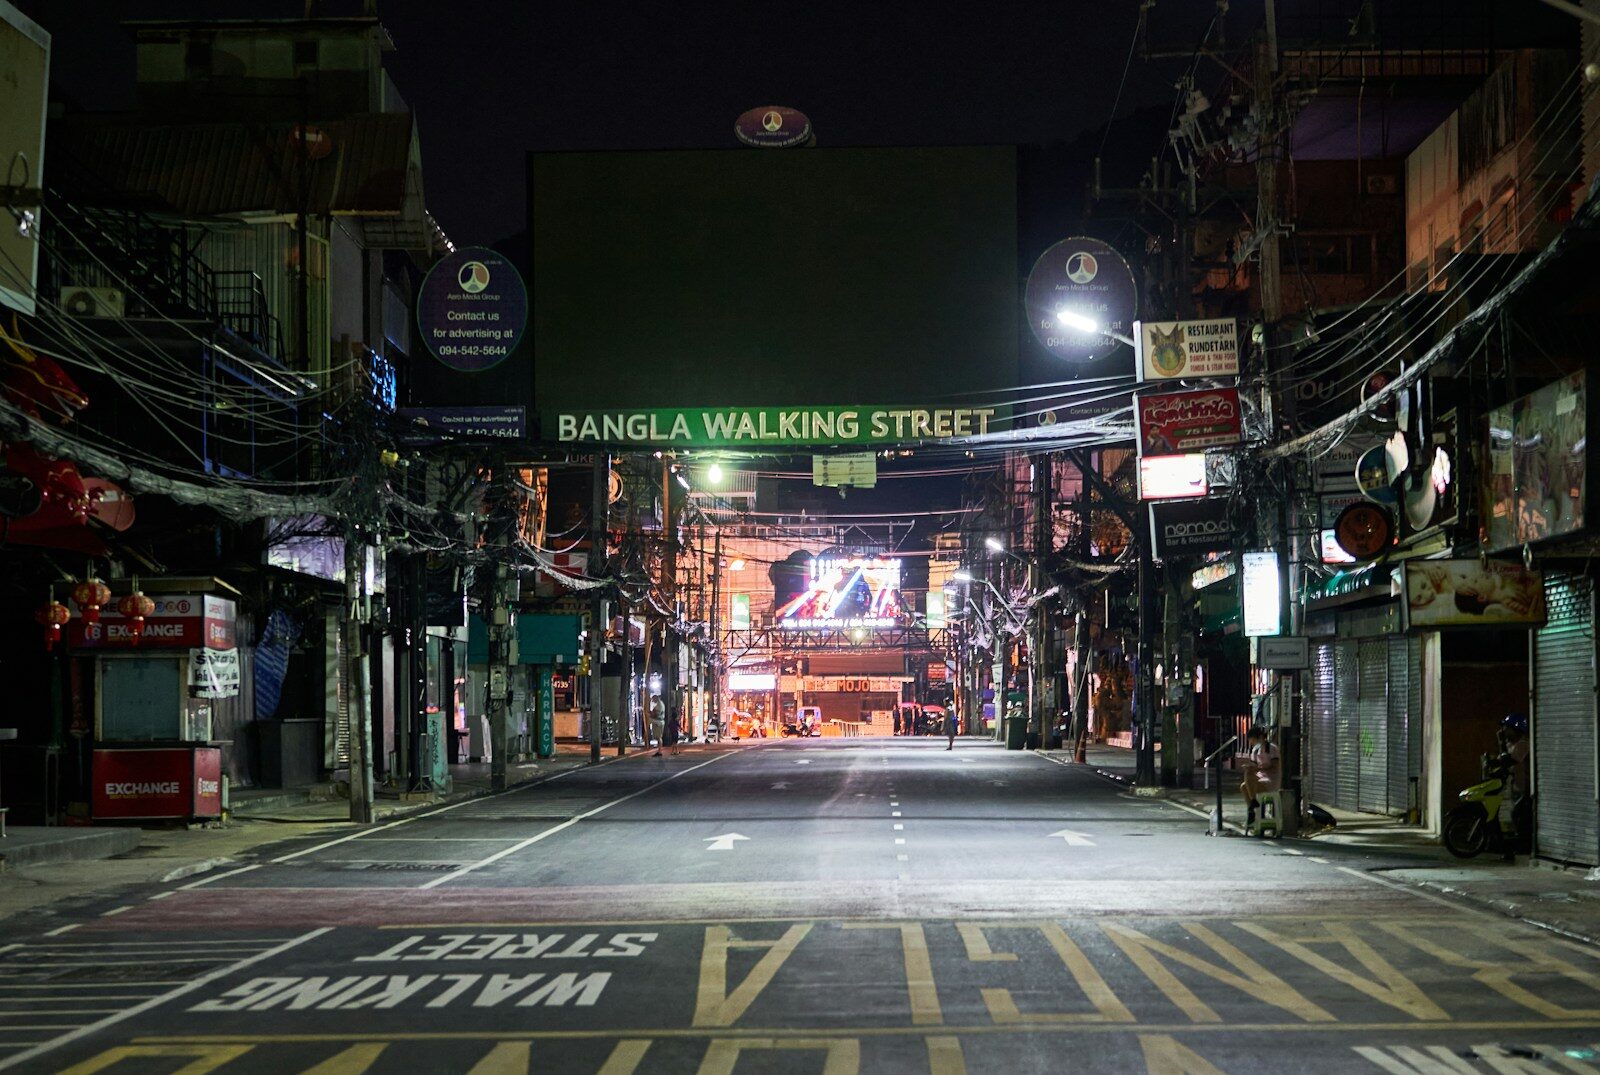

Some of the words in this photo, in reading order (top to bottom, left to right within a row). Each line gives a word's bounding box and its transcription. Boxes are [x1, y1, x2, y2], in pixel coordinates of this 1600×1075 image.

[447, 311, 485, 321] Contact
[486, 312, 500, 321] us
[1112, 321, 1122, 329] at
[1187, 323, 1235, 336] RESTAURANT
[433, 328, 448, 339] for
[449, 329, 502, 341] advertising
[504, 329, 514, 339] at
[439, 346, 507, 356] 094-542-5644
[558, 413, 692, 442] BANGLA
[702, 410, 859, 440] WALKING
[871, 408, 995, 438] STREET
[1165, 537, 1179, 547] Bar
[1180, 537, 1187, 545] &
[837, 680, 870, 692] MOJO
[105, 781, 181, 796] EXCHANGE
[353, 932, 659, 963] STREET
[186, 971, 612, 1013] WALKING
